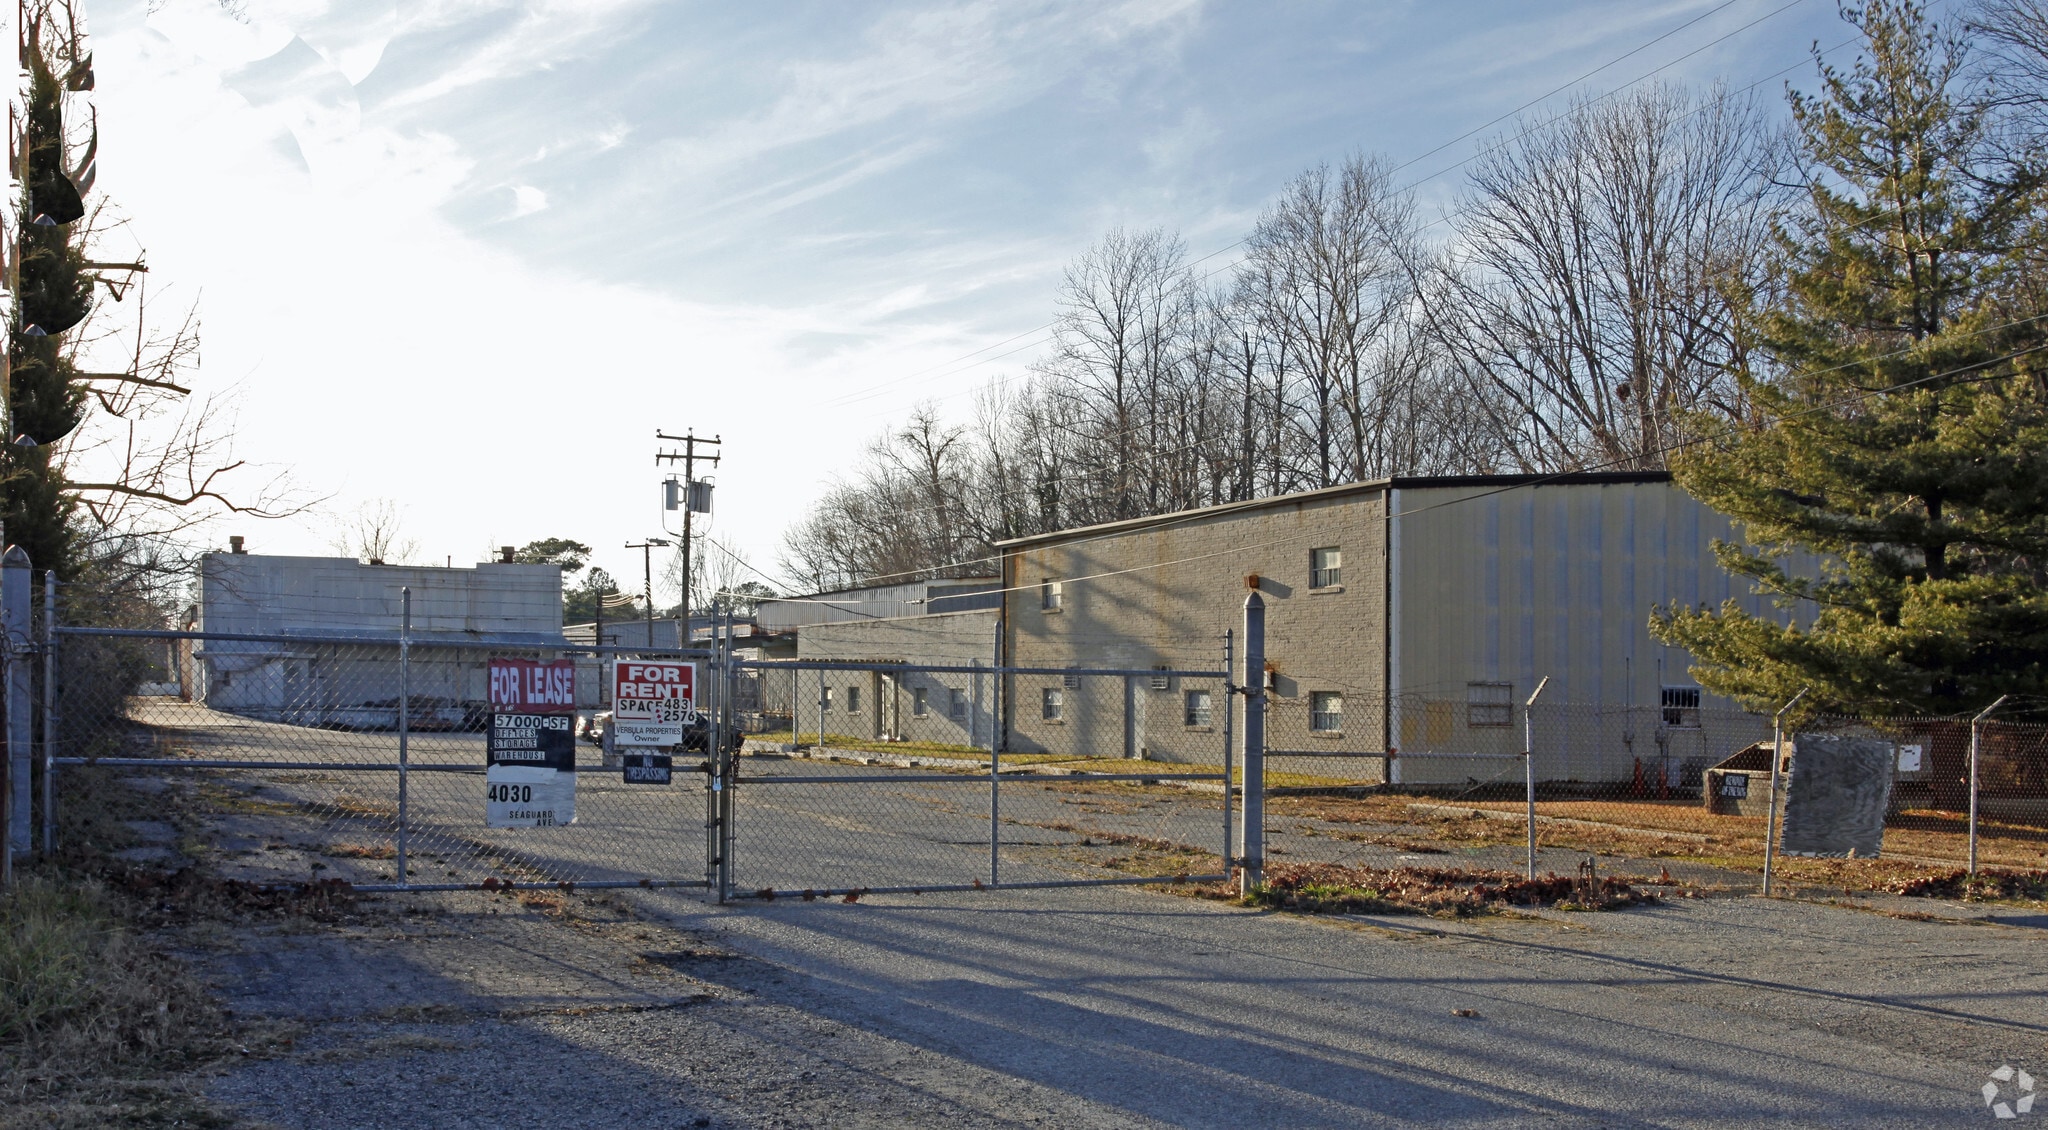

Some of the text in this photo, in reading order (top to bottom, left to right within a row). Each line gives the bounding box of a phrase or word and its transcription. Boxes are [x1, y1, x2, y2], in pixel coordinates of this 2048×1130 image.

[629, 666, 680, 682] FOR
[491, 666, 572, 705] FOR LEASE
[620, 682, 689, 699] RENT
[664, 699, 689, 710] 483
[664, 711, 695, 722] 2576
[645, 727, 681, 735] PROPERTIES
[495, 739, 536, 748] STORAGE
[495, 751, 544, 760] WAREHOUSE
[626, 767, 669, 780] TRESPASSING
[489, 785, 531, 803] 4030
[509, 810, 553, 819] SEAGUARD
[536, 819, 552, 827] AVE
